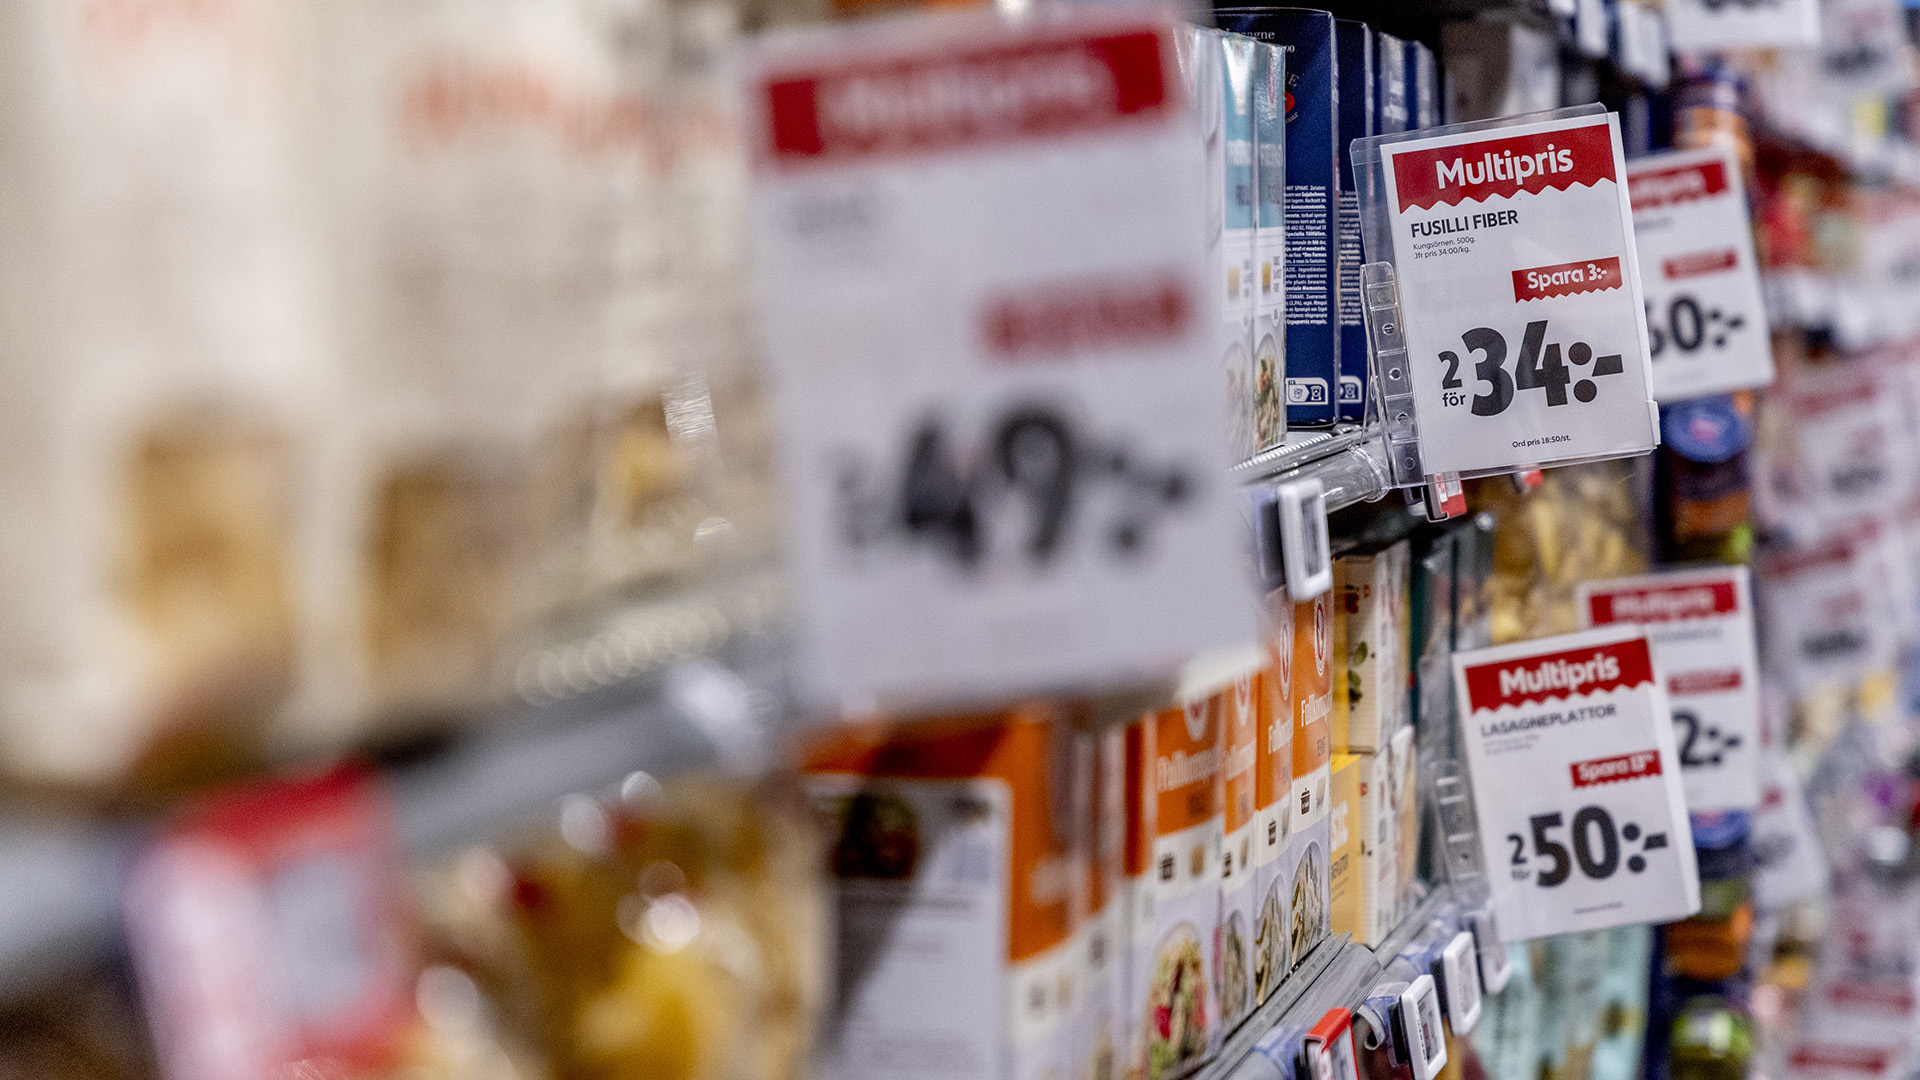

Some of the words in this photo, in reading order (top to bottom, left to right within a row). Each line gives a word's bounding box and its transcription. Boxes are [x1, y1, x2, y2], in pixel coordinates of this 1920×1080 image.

[1225, 27, 1275, 41] sagne
[1435, 143, 1574, 189] Multipris
[1411, 216, 1470, 238] FUSILLI
[1473, 210, 1519, 230] FIBER
[1413, 238, 1455, 251] Kungsörnen.
[1457, 236, 1477, 246] 500g.
[1424, 250, 1438, 260] pris
[1527, 266, 1583, 291] Spara
[1438, 350, 1463, 390] 2
[1461, 319, 1624, 417] 34:-
[1442, 392, 1466, 407] för
[1512, 440, 1526, 448] Ord
[1526, 438, 1541, 449] pris
[1541, 434, 1572, 445] 18:50/st.
[1499, 652, 1621, 697] Multipris
[1481, 703, 1617, 738] LASAGNEPLATTOR
[1576, 758, 1628, 782] Spara
[1507, 833, 1527, 865] 2
[1529, 804, 1669, 888] 50:-
